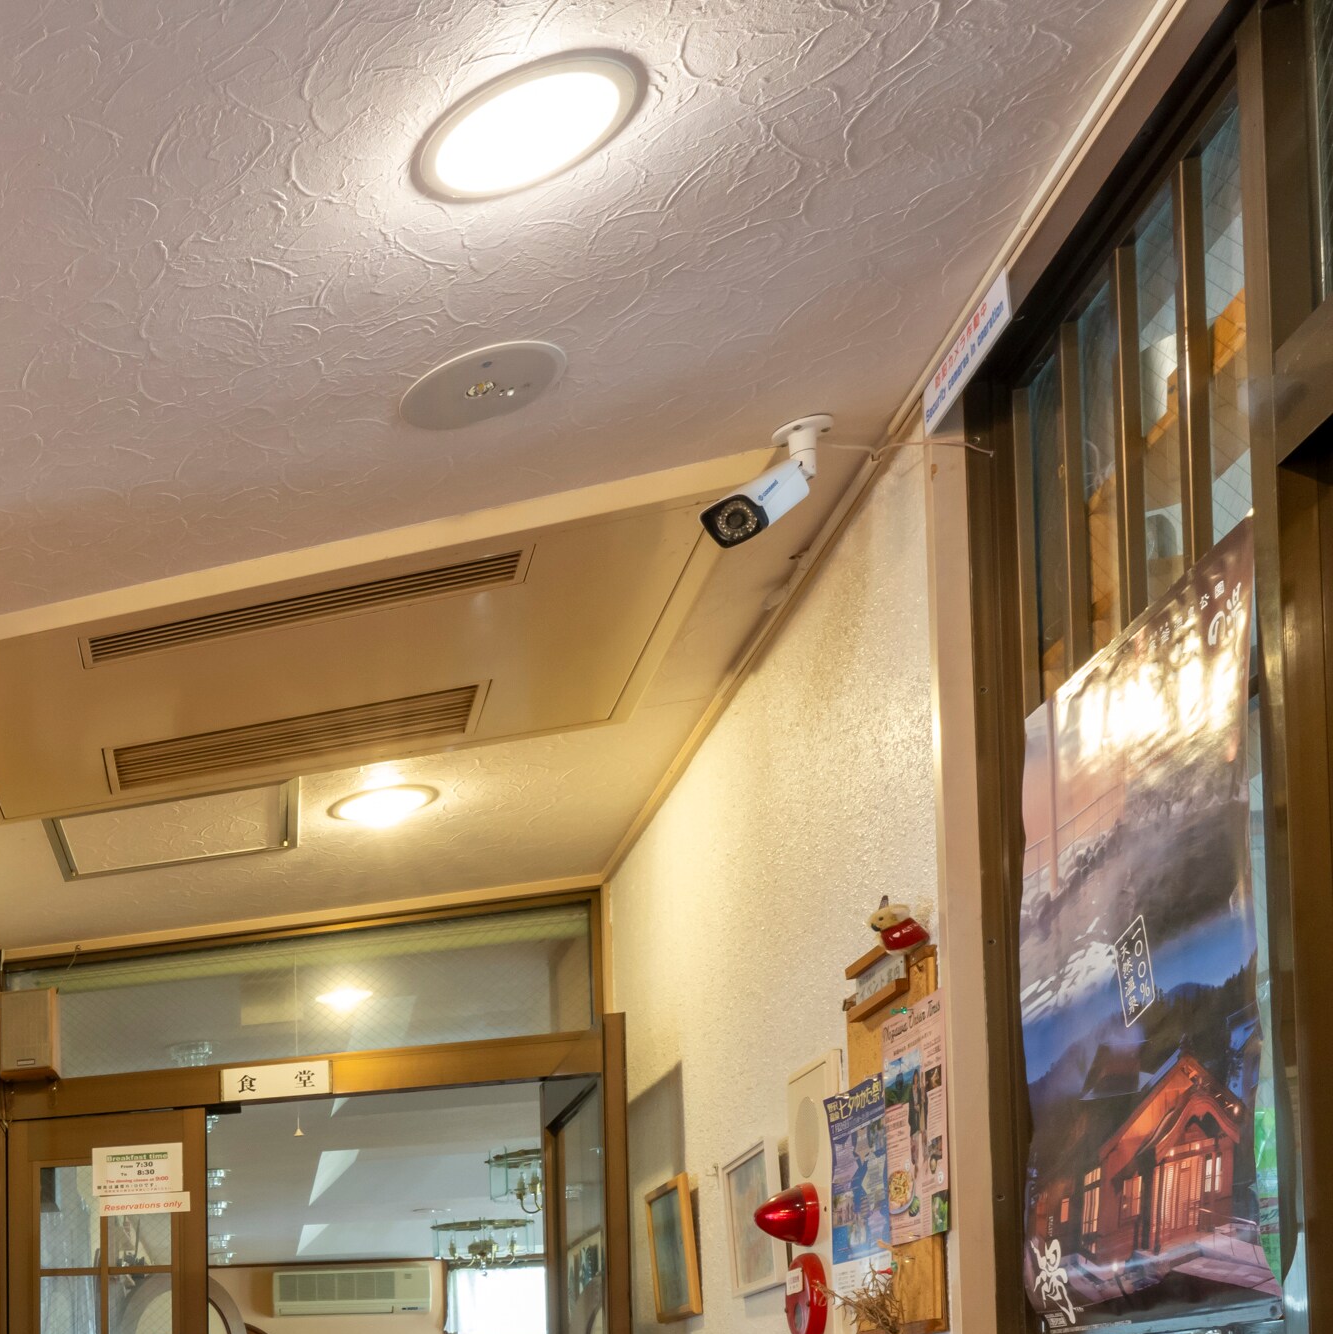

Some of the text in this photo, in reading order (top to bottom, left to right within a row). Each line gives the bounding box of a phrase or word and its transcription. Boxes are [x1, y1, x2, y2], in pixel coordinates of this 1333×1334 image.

[237, 1069, 315, 1094] 食堂
[106, 1152, 168, 1162] Breakfast time
[103, 1200, 182, 1211] Reservations only
